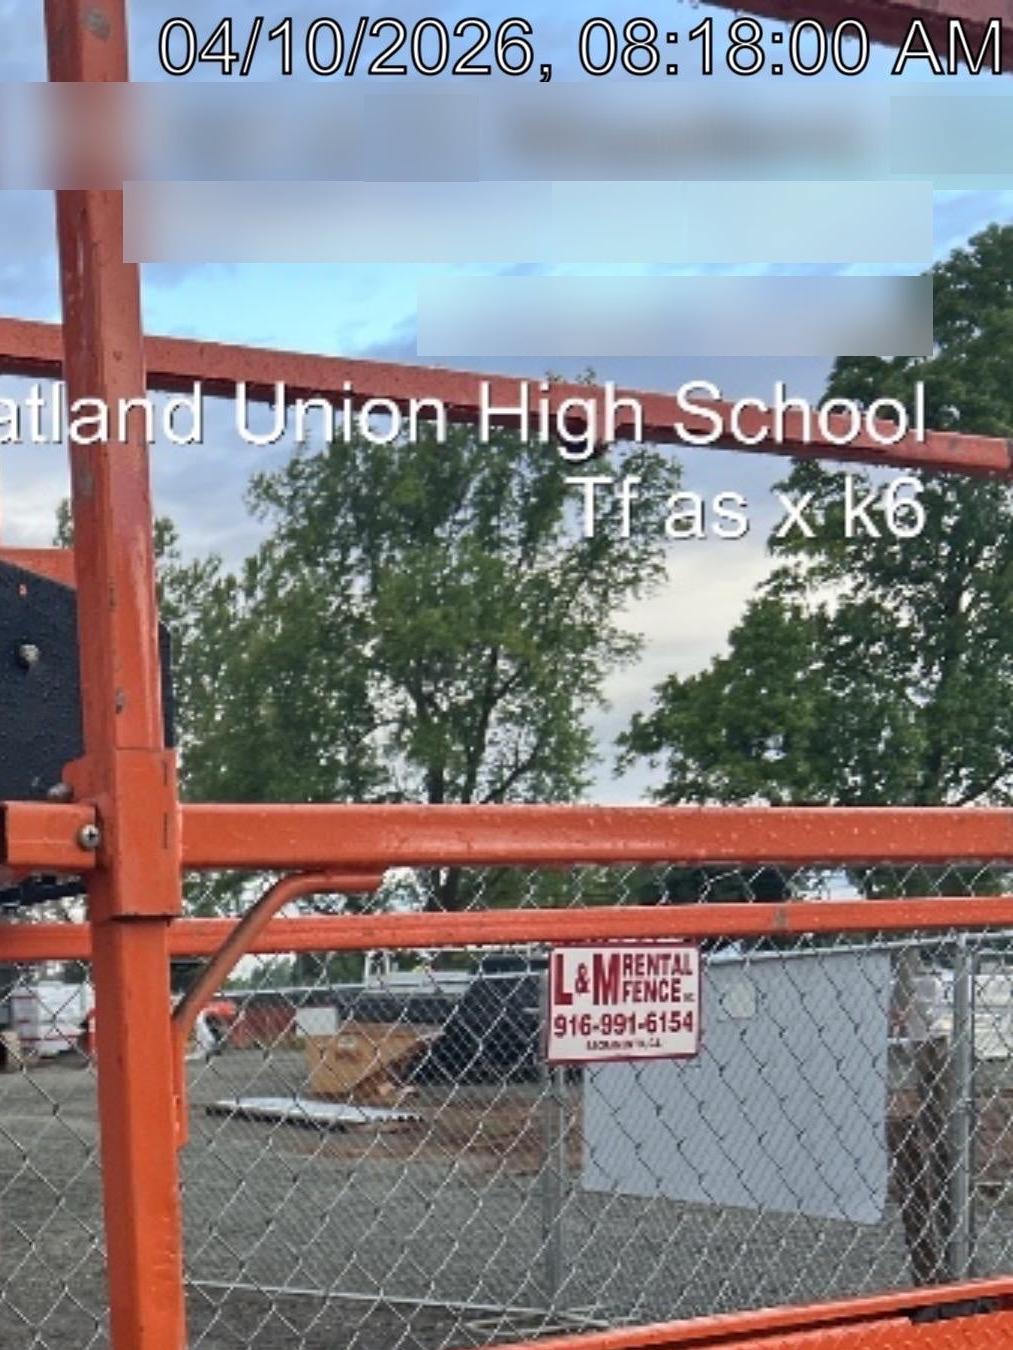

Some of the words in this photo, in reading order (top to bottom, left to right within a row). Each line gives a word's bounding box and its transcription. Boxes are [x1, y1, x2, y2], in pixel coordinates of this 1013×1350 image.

[554, 953, 621, 1006] L&M
[622, 953, 693, 976] RENTAL
[622, 979, 681, 1003] FENCE
[553, 1010, 694, 1037] 916-991-6154
